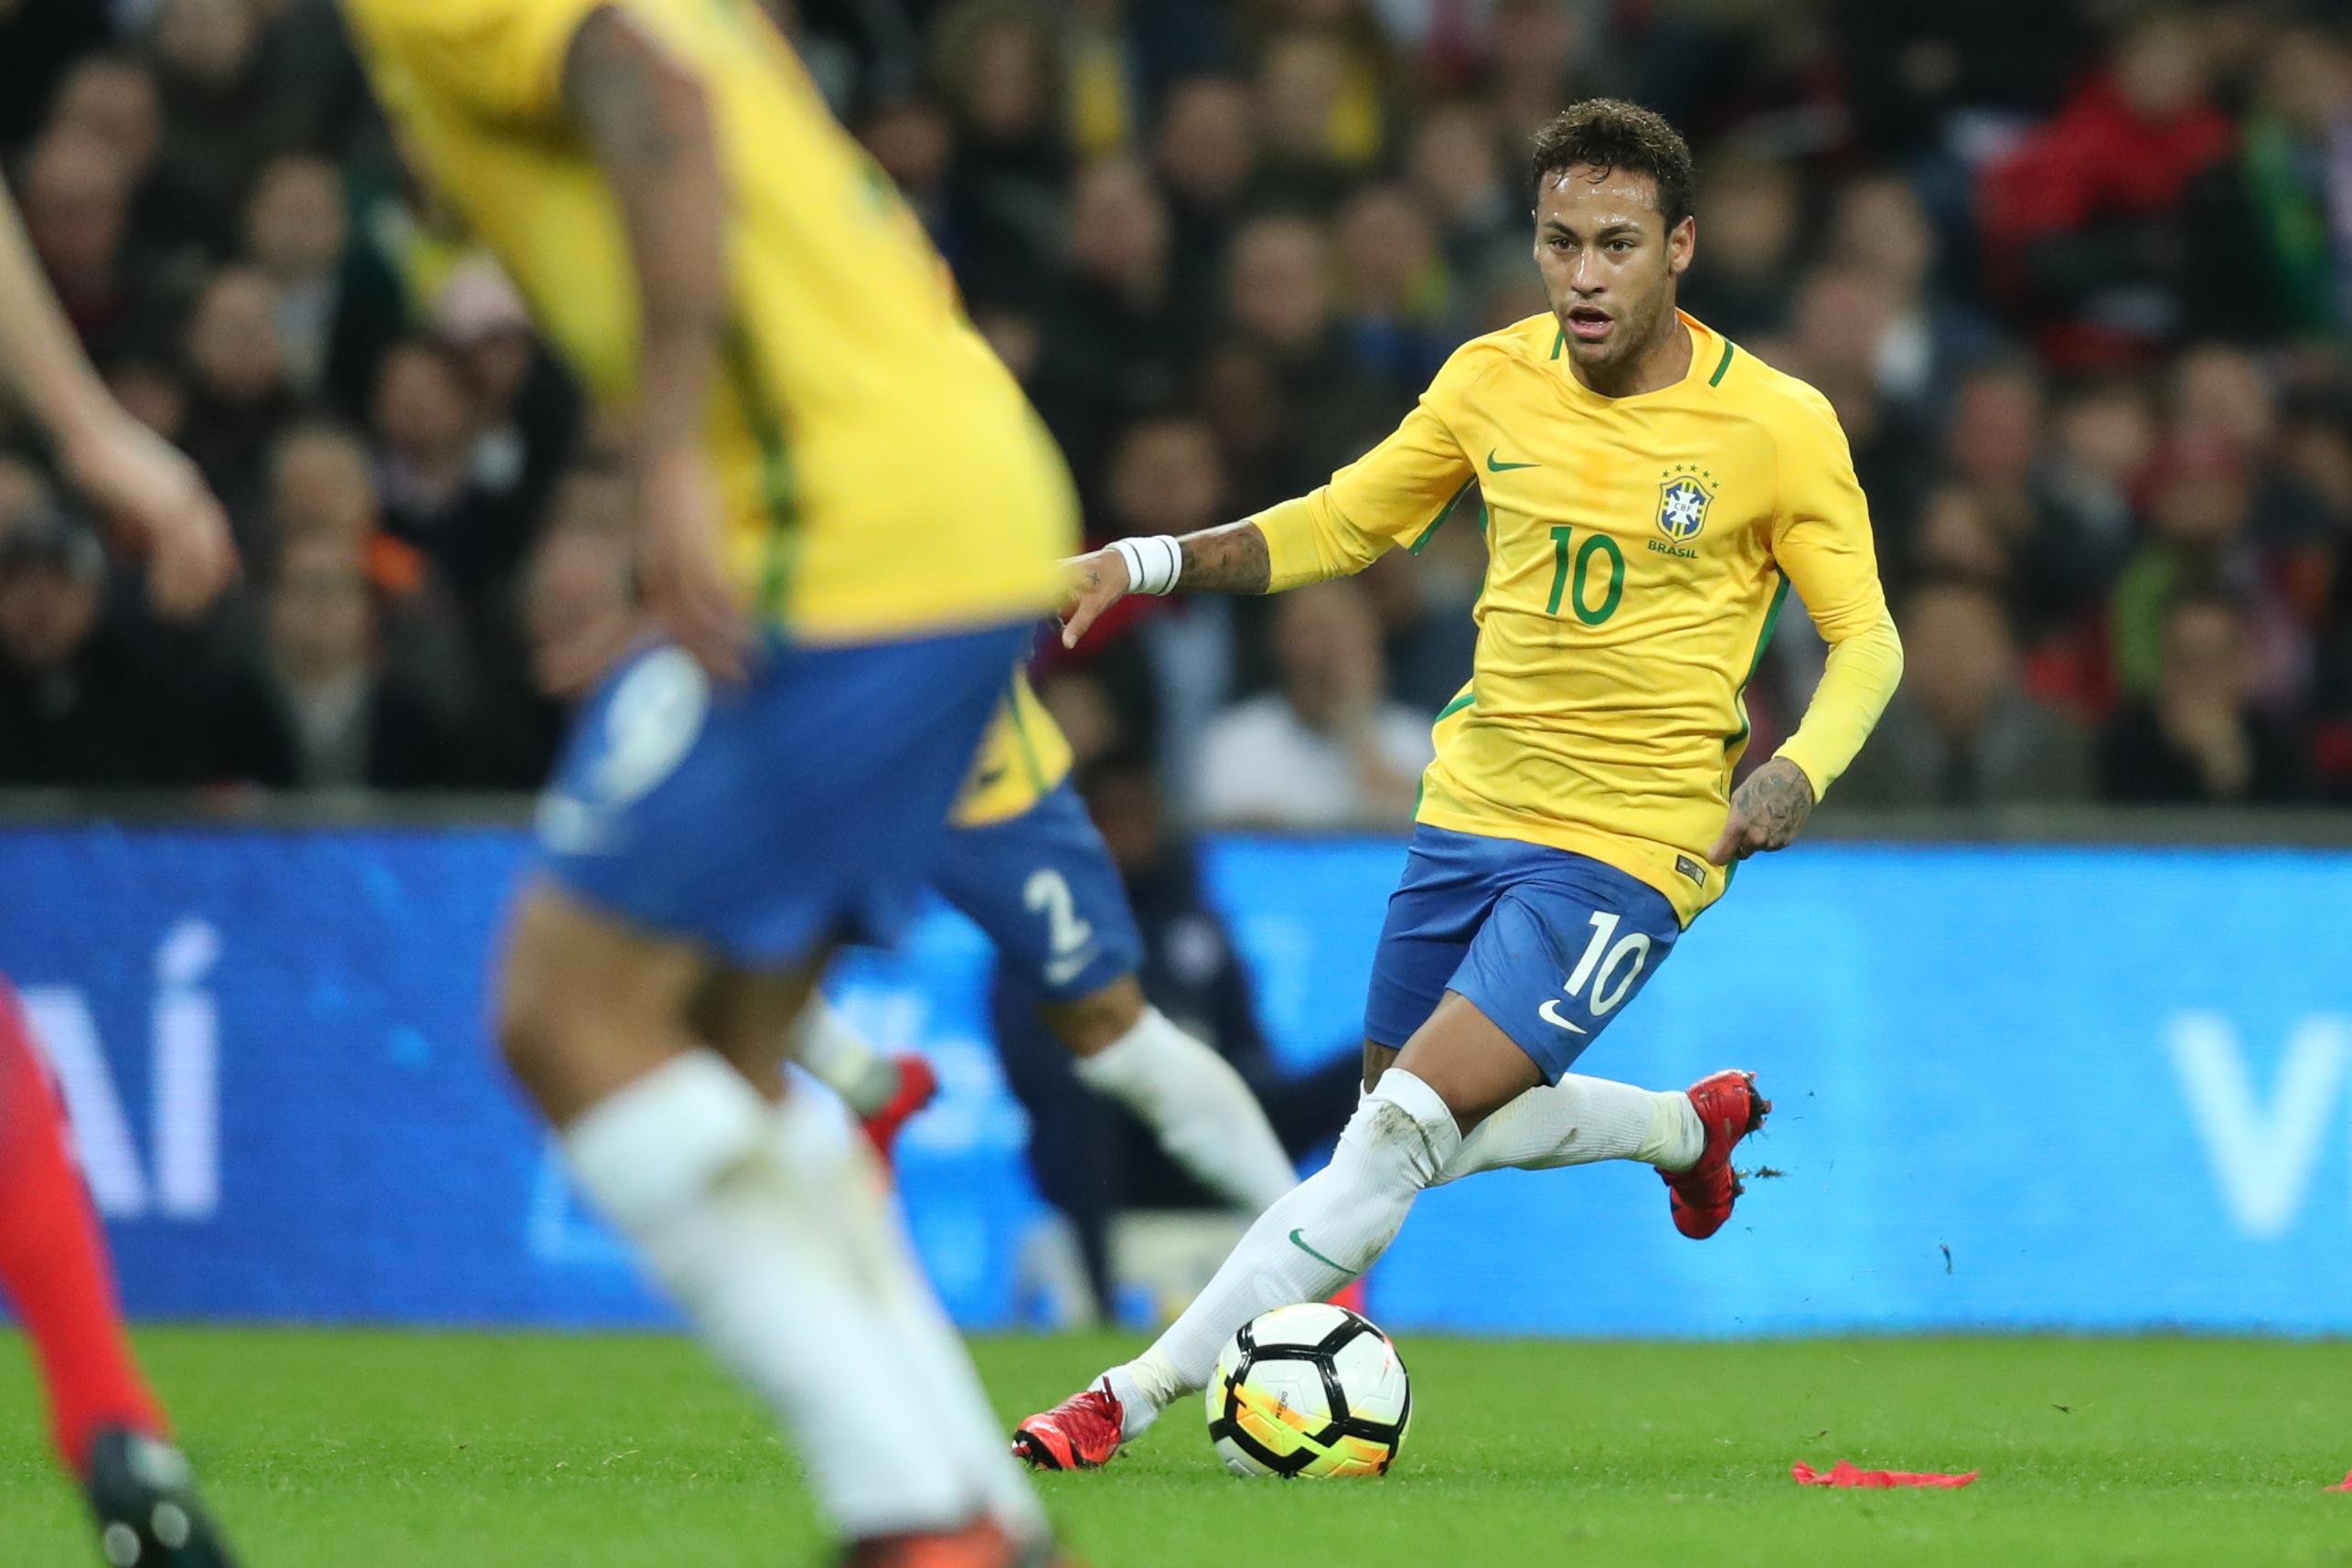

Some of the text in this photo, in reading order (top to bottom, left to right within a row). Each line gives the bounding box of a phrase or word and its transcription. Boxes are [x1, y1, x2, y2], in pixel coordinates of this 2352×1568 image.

[1648, 539, 1698, 559] BRASIL
[1673, 502, 1694, 513] CBF
[1545, 526, 1625, 625] 10
[1023, 868, 1093, 955] 2
[1563, 910, 1651, 1017] 10
